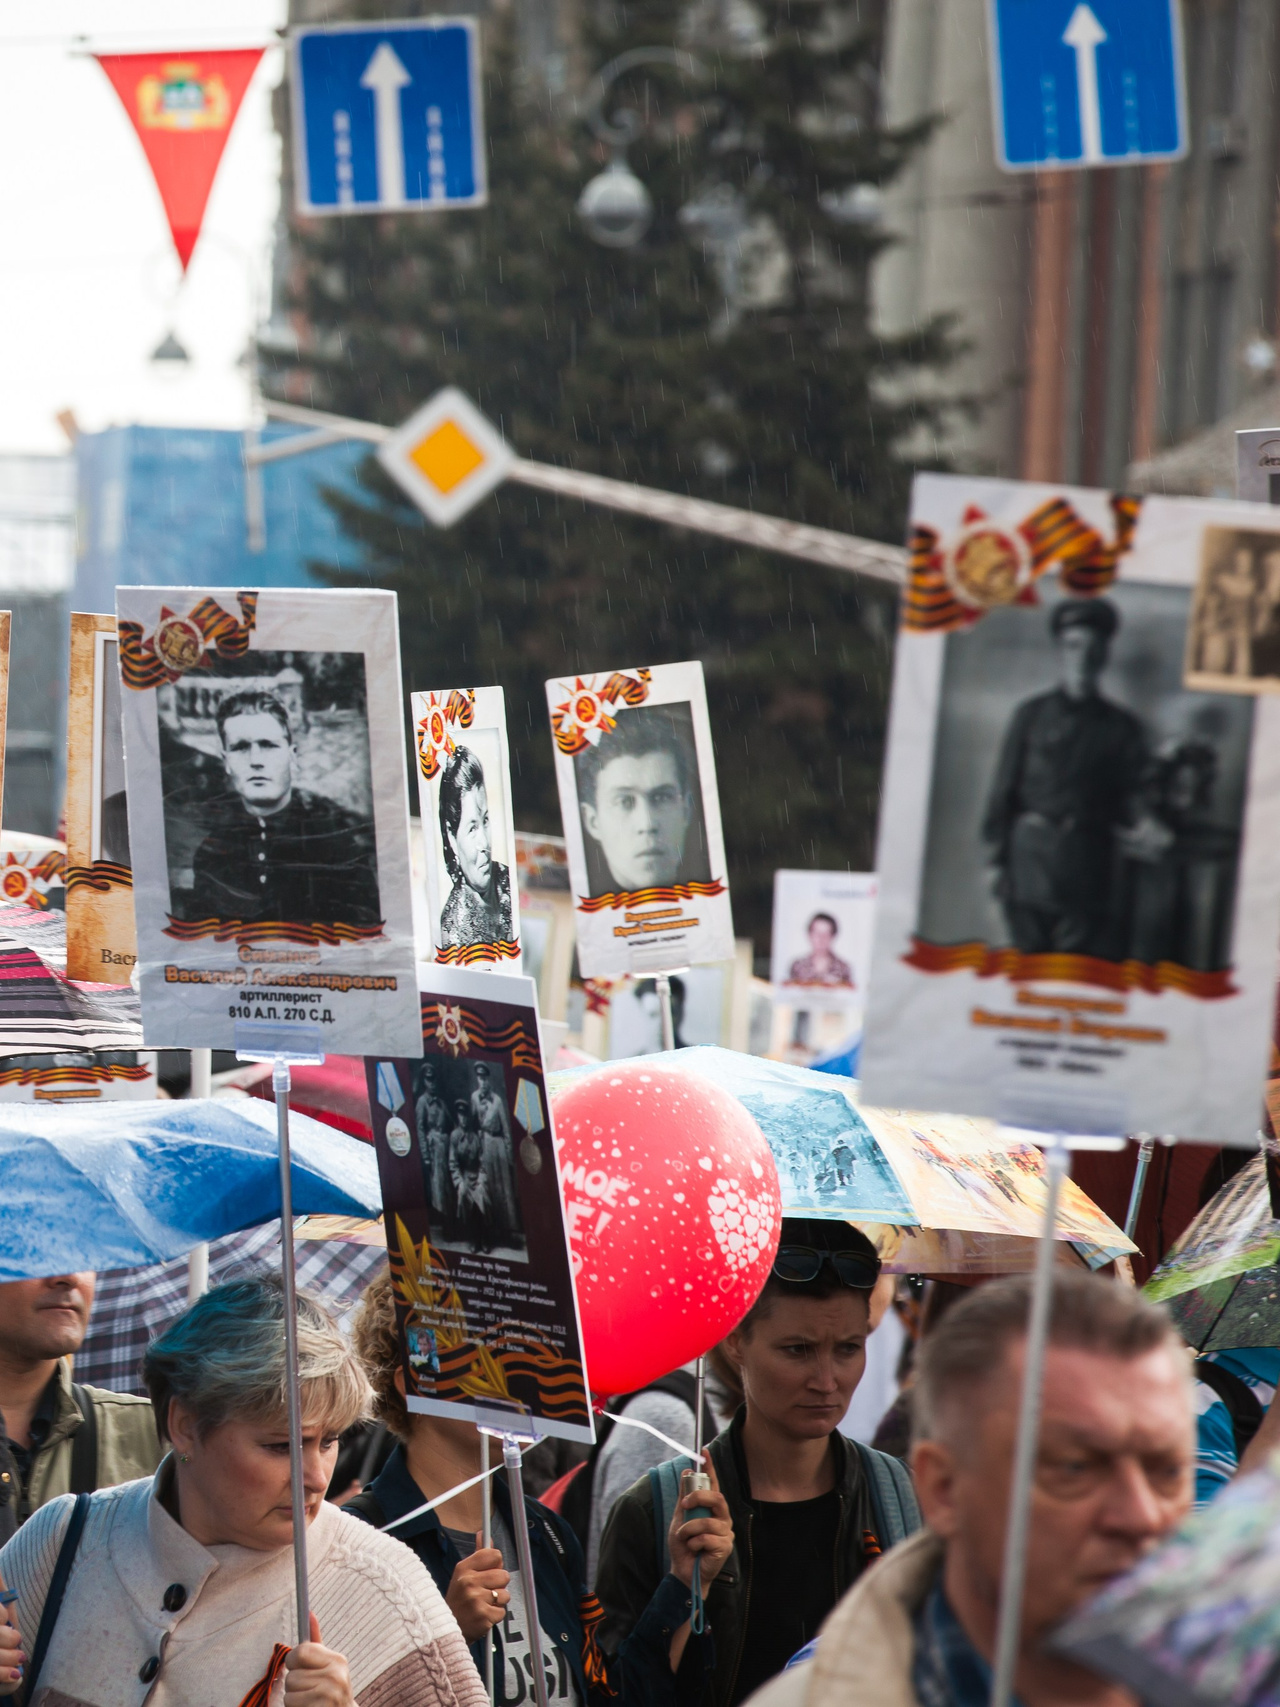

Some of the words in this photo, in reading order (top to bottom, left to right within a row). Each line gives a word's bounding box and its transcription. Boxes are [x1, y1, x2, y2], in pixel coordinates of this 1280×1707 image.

[164, 965, 247, 986] Василий
[250, 968, 398, 991] Александрович
[239, 990, 322, 1004] артиллерист
[228, 1006, 251, 1019] 810
[254, 1007, 280, 1020] А.П.
[283, 1009, 306, 1021] 270
[309, 1010, 336, 1024] С.Д.
